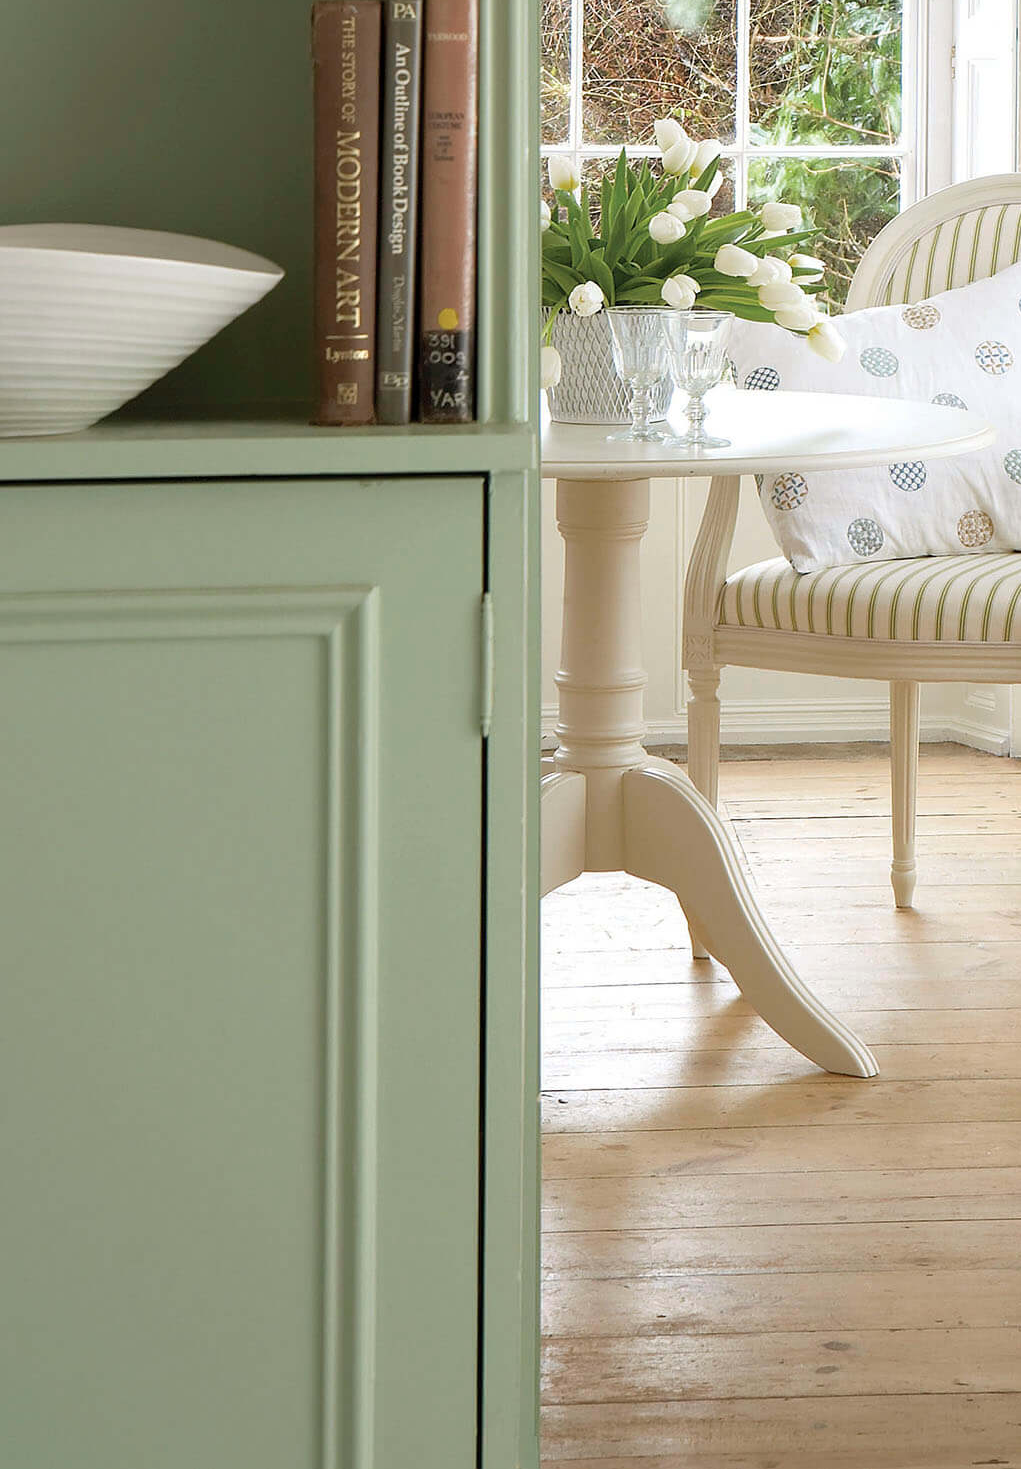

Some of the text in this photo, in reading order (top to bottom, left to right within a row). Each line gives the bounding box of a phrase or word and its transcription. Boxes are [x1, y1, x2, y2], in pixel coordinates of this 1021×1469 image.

[393, 3, 416, 19] PA
[395, 43, 411, 66] An
[394, 69, 411, 131] Outline
[393, 133, 410, 151] of
[336, 17, 361, 329] THE STORY OF MODERN ART
[392, 154, 409, 196] Book
[388, 198, 408, 254] Design
[428, 334, 455, 349] 391
